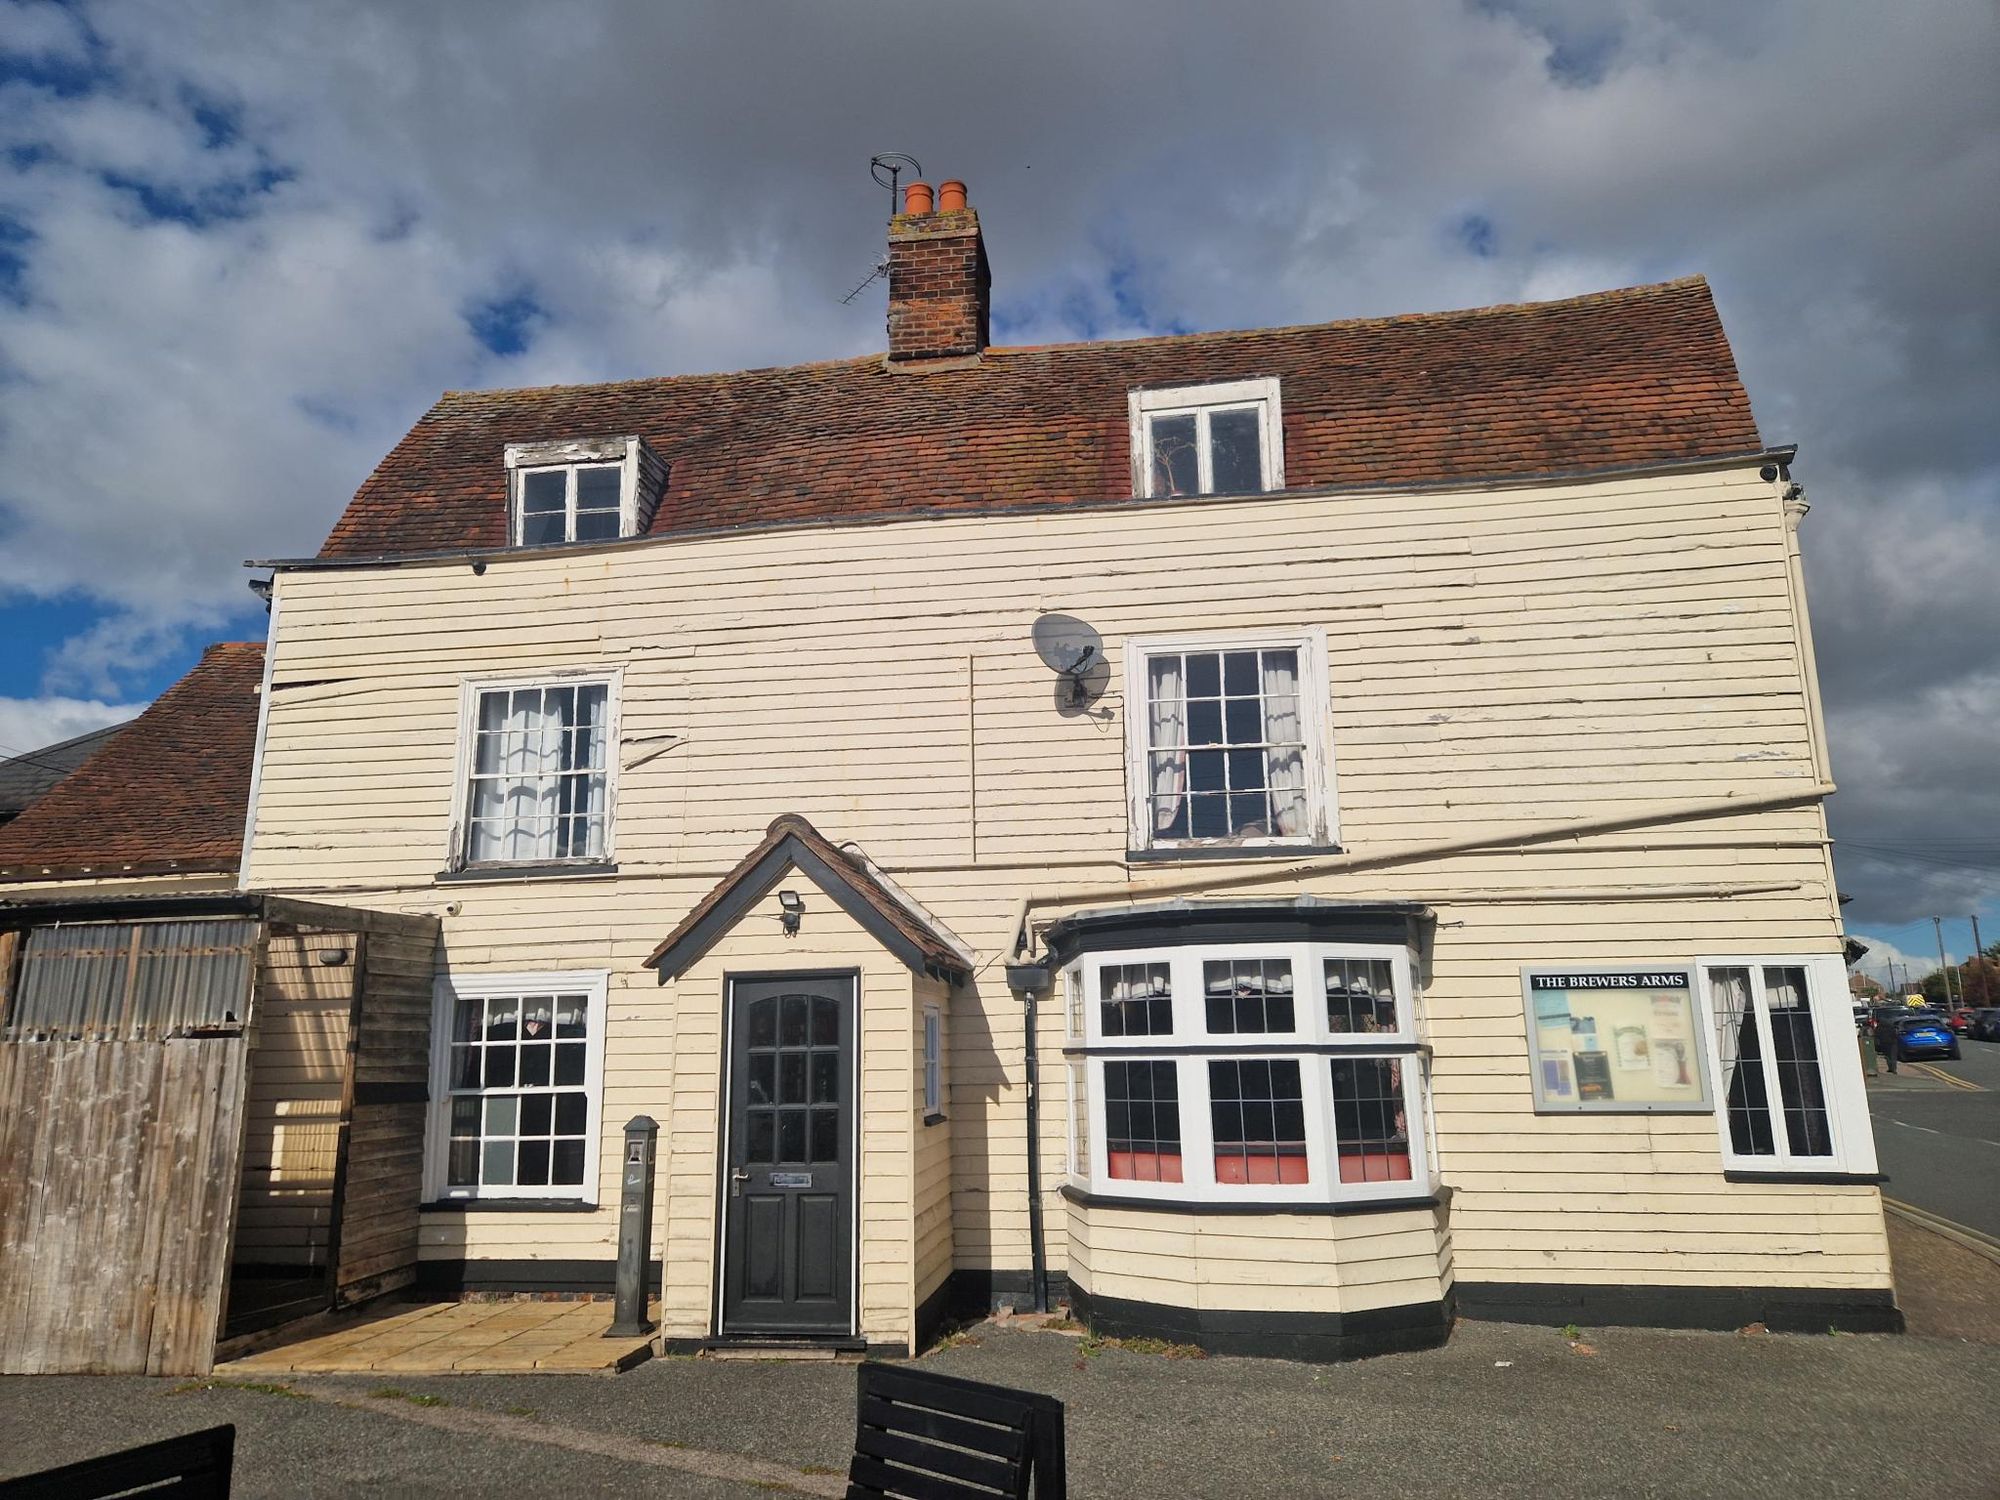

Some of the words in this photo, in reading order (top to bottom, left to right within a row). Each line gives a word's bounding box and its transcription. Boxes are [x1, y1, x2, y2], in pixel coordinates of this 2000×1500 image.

[1536, 977, 1566, 988] THE
[1569, 976, 1637, 987] BREWERS
[1641, 975, 1683, 986] ARMS
